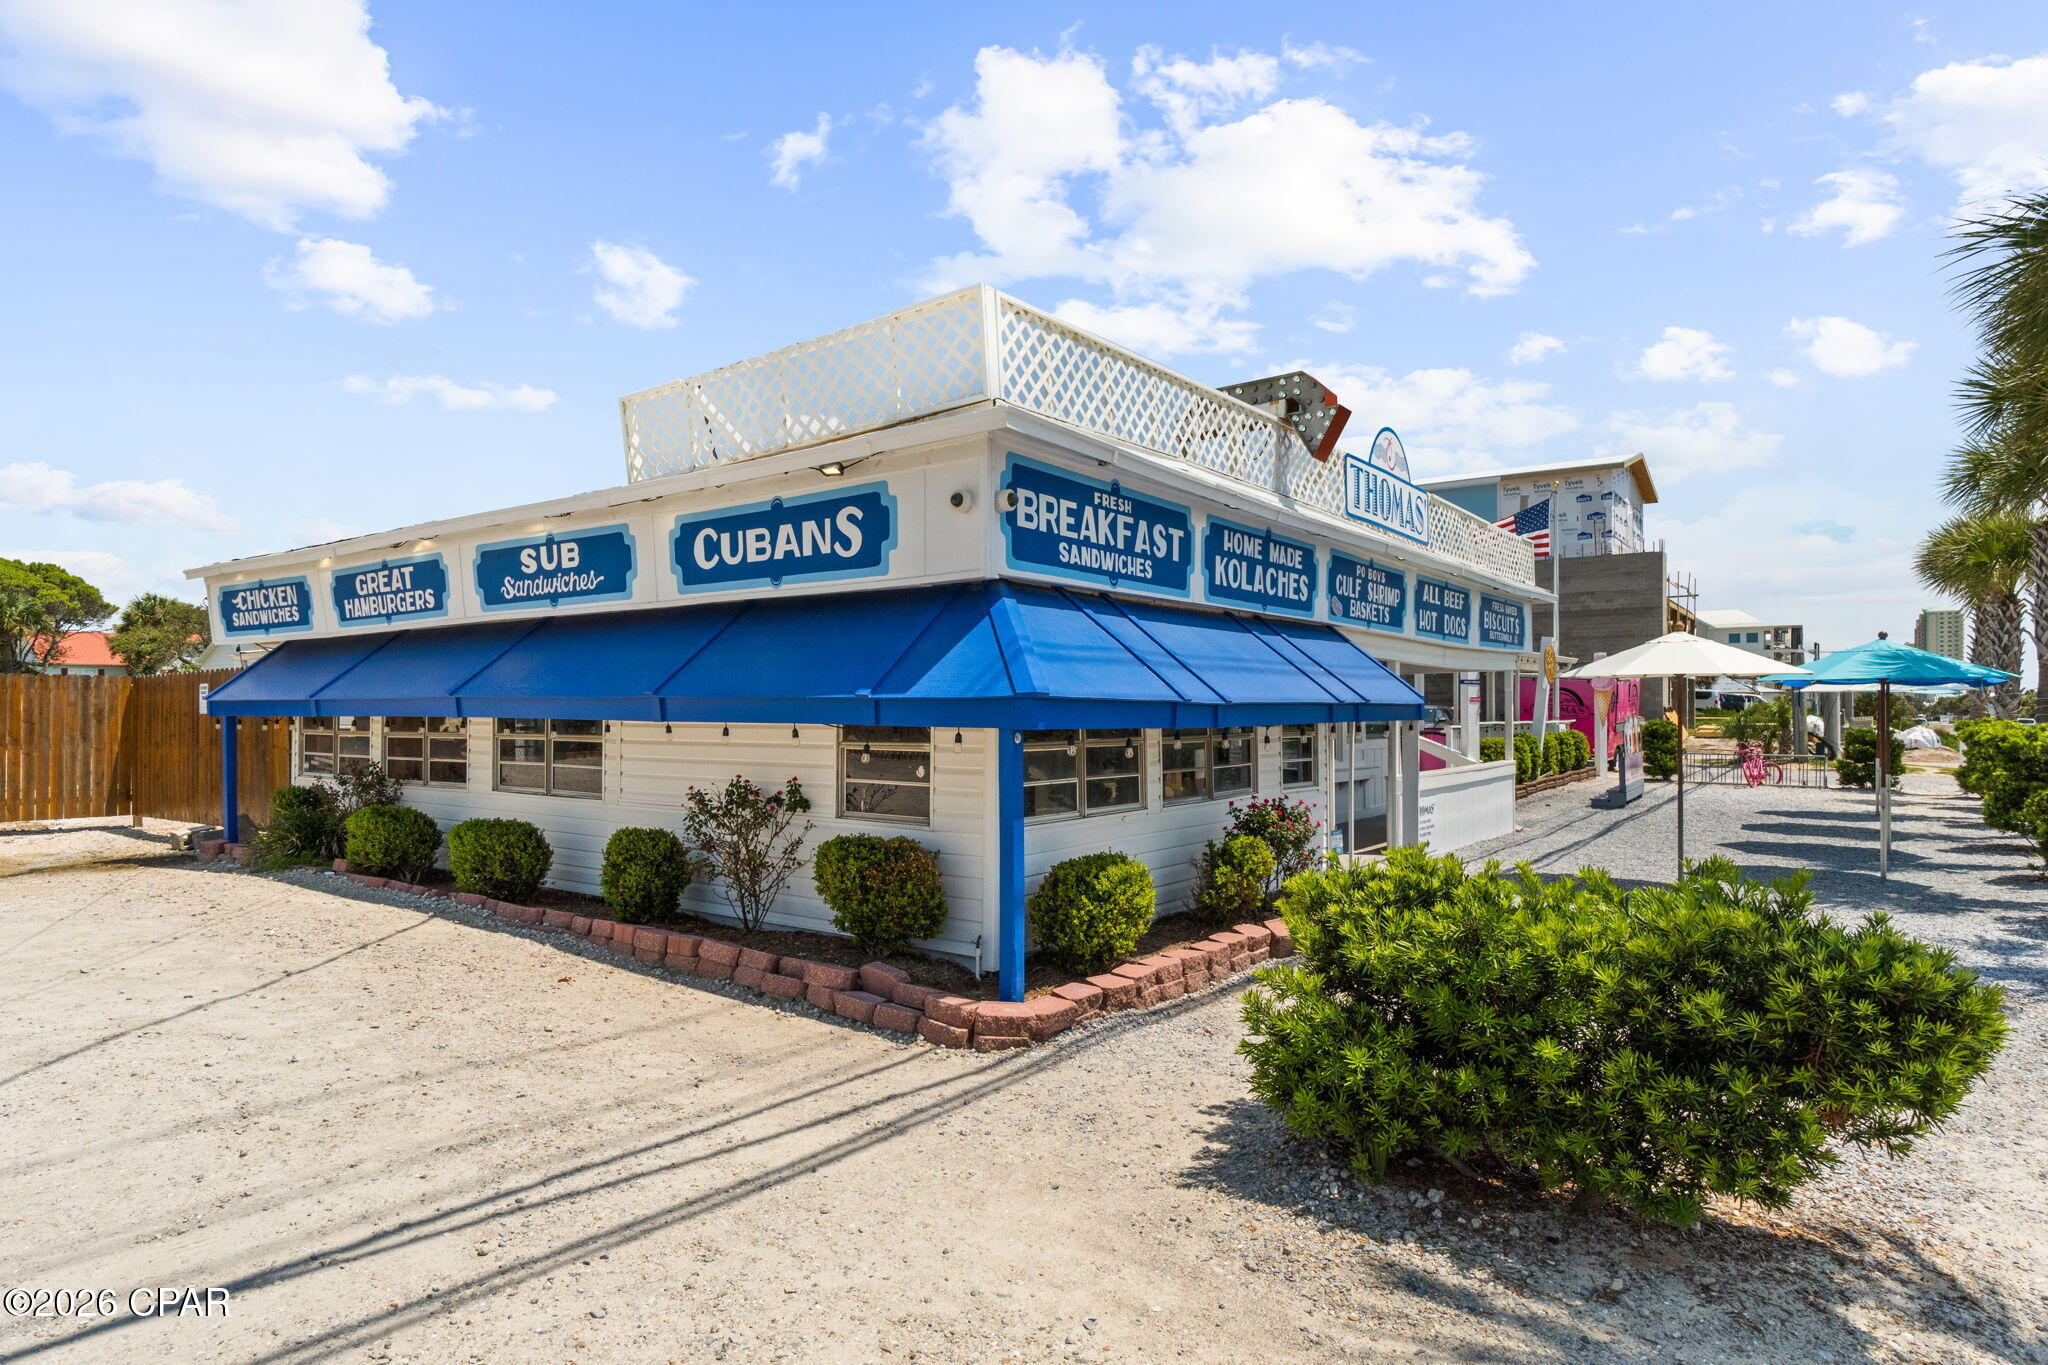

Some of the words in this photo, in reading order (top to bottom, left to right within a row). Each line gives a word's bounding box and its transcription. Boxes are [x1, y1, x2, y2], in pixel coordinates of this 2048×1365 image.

[1503, 486, 1521, 494] Tyvek
[1533, 482, 1551, 490] Tyvek
[1094, 492, 1132, 512] FRESH
[693, 506, 864, 570] CUBANS
[1016, 487, 1184, 562] BREAKFAST
[519, 541, 580, 574] SUB
[1059, 542, 1153, 579] SANDWICHES
[1223, 530, 1262, 559] HOME
[1269, 540, 1303, 570] MADE
[355, 566, 414, 595] GREAT
[500, 569, 605, 600] Sandwiches
[1214, 555, 1309, 602] KOLACHES
[1356, 565, 1365, 578] PO
[1368, 568, 1386, 584] BOYS
[232, 584, 298, 611] CHICKEN
[344, 588, 435, 619] HAMBURGERS
[1335, 574, 1362, 598] GULF
[1367, 582, 1401, 607] SHRIMP
[1422, 584, 1441, 605] ALL
[1443, 589, 1465, 610] BEEF
[232, 604, 300, 627] SANDWICHES
[1349, 599, 1390, 624] BASKETS
[1419, 609, 1438, 631] HOT
[1443, 614, 1466, 637] DOGS
[1484, 610, 1520, 634] BISCUITS
